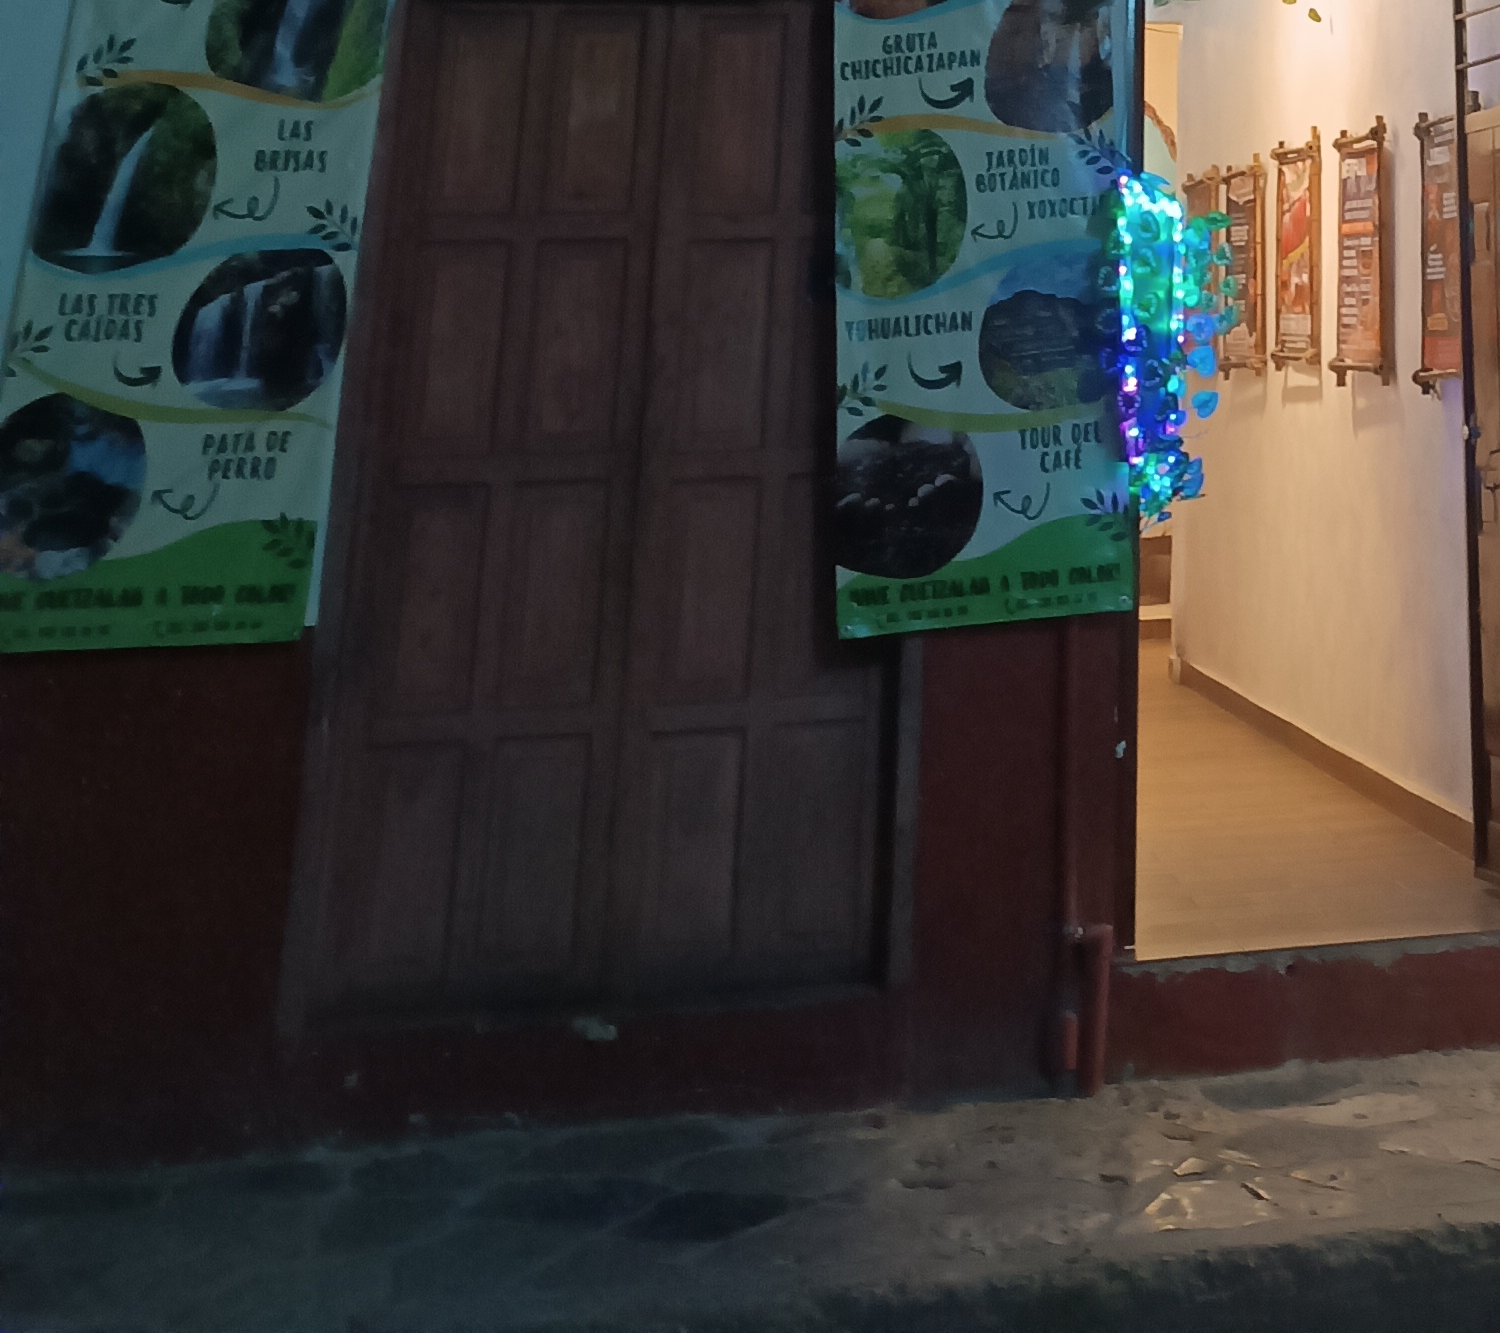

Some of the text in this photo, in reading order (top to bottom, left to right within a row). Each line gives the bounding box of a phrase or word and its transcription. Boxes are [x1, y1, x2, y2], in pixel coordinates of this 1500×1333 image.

[882, 31, 938, 56] GRUTA
[840, 49, 982, 81] CHICHICAZAPAN
[277, 118, 315, 142] LAS
[985, 143, 1049, 173] JARDÍN
[975, 166, 1060, 193] BOTÁNICO
[58, 292, 158, 317] LAS TRES
[201, 429, 293, 455] PATA DE
[1018, 420, 1103, 450] TOUR DEL
[207, 454, 278, 481] PERRO
[1038, 442, 1083, 473] CAFÉ
